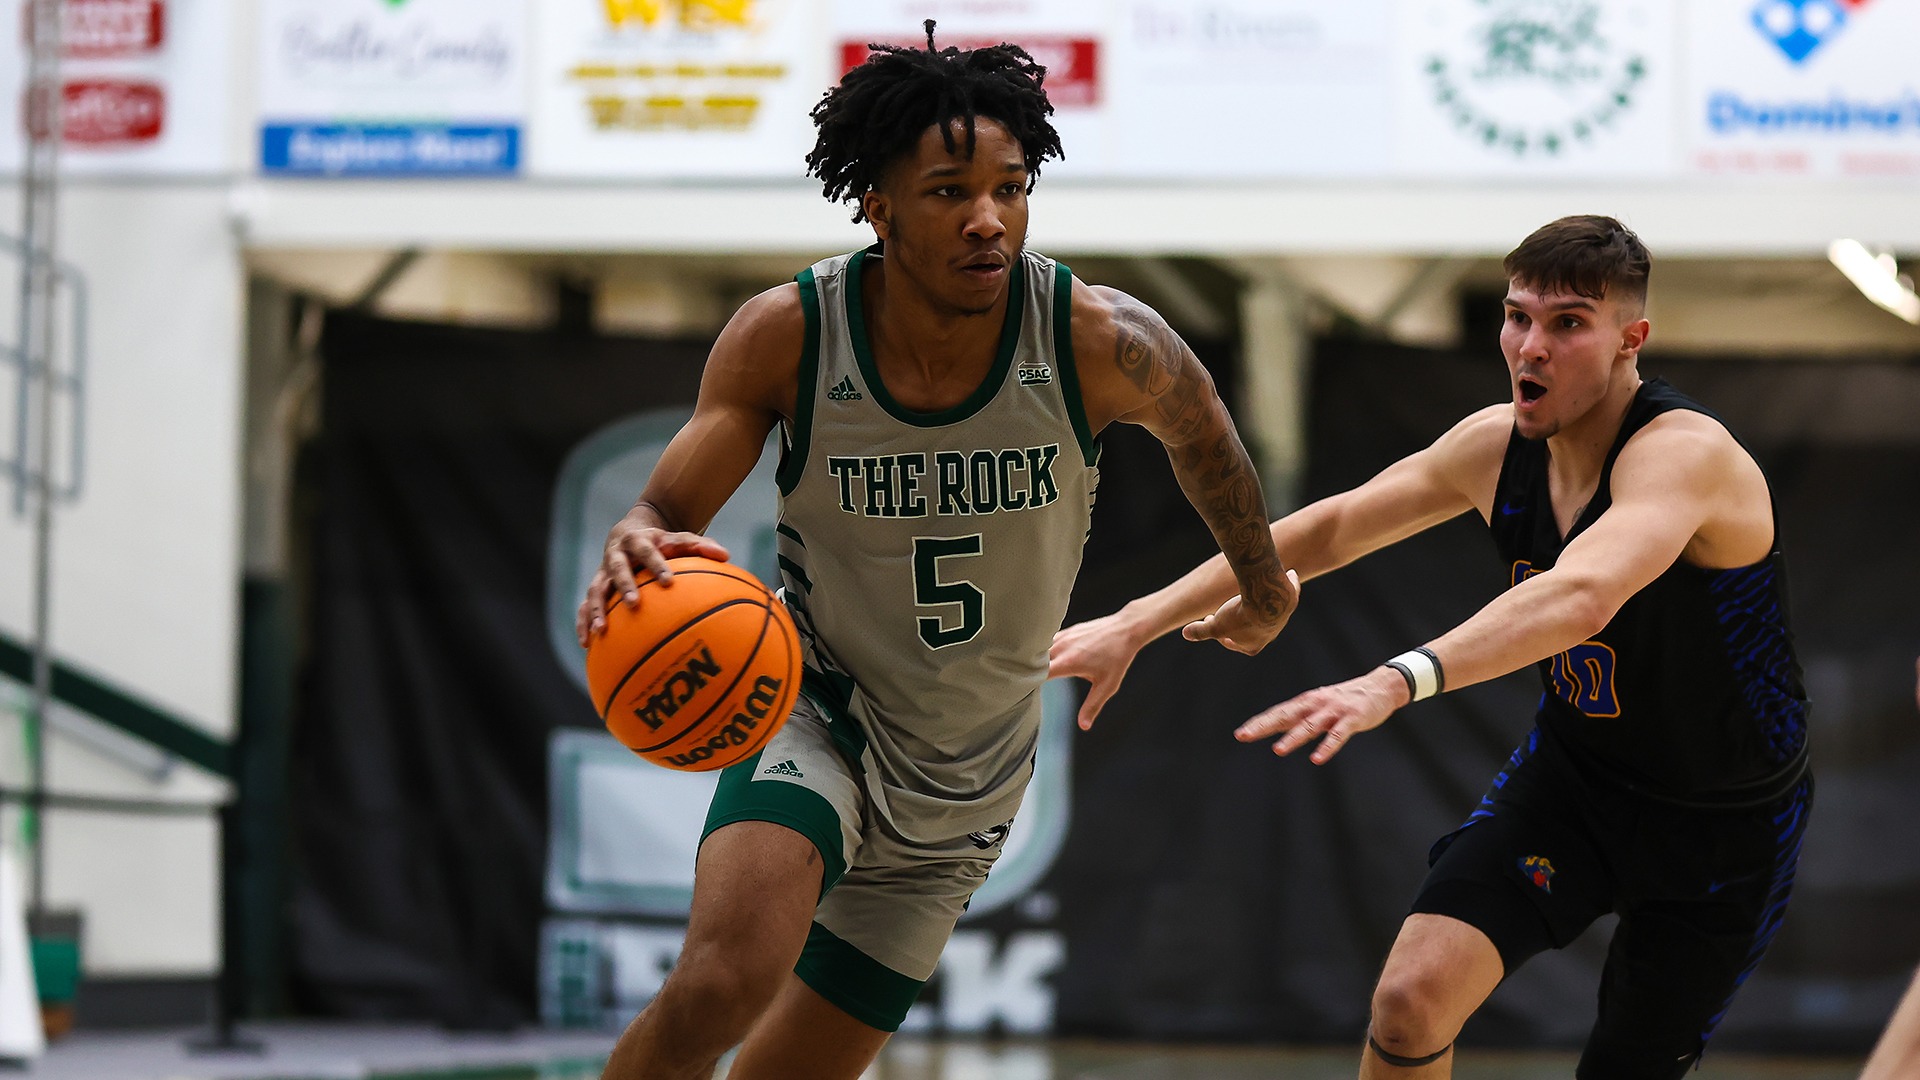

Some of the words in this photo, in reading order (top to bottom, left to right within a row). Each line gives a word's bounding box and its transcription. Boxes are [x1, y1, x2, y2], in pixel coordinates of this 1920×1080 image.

[1706, 86, 1920, 133] Domino'
[827, 390, 863, 401] adidas
[1019, 368, 1051, 380] PSAC
[827, 452, 929, 519] THE
[935, 442, 1061, 516] ROCK
[911, 532, 986, 652] 5
[634, 645, 723, 733] NCAA
[661, 673, 784, 768] Wilson
[763, 767, 805, 779] adidas
